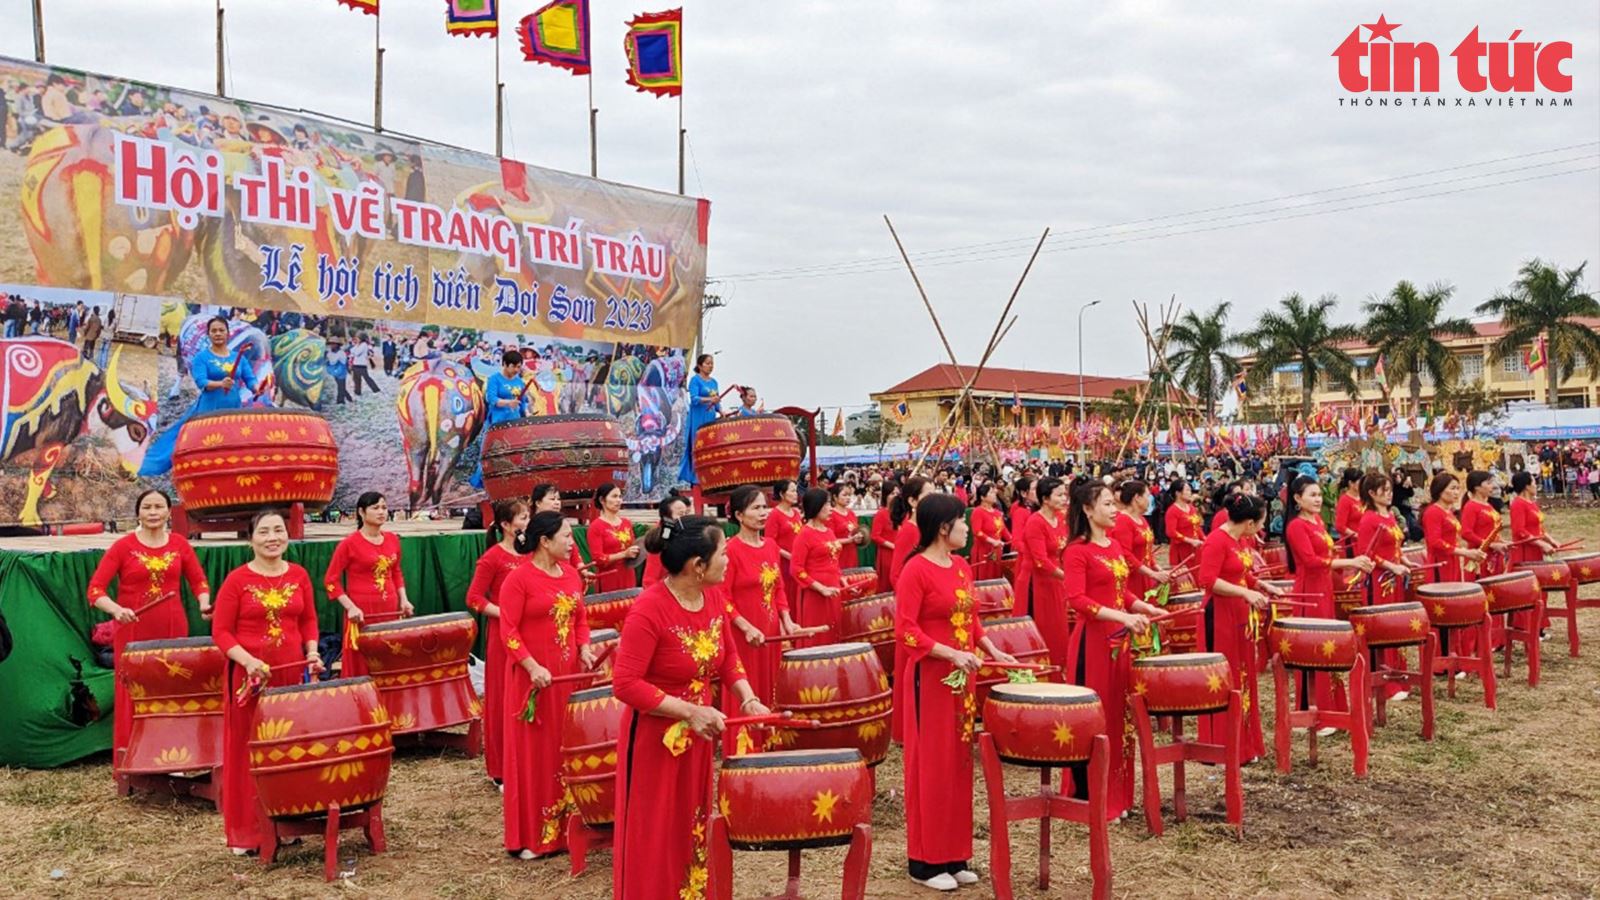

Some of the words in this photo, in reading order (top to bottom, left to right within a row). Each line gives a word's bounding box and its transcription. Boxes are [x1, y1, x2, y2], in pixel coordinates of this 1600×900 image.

[120, 139, 219, 224] Hội
[396, 203, 517, 268] TRANG
[527, 222, 581, 265] TRÍ
[591, 235, 665, 278] TRÂU
[260, 244, 304, 291] Lễ
[318, 254, 358, 306] hội
[373, 263, 419, 311] tịch
[433, 265, 480, 311] điền
[604, 299, 652, 331] 2023
